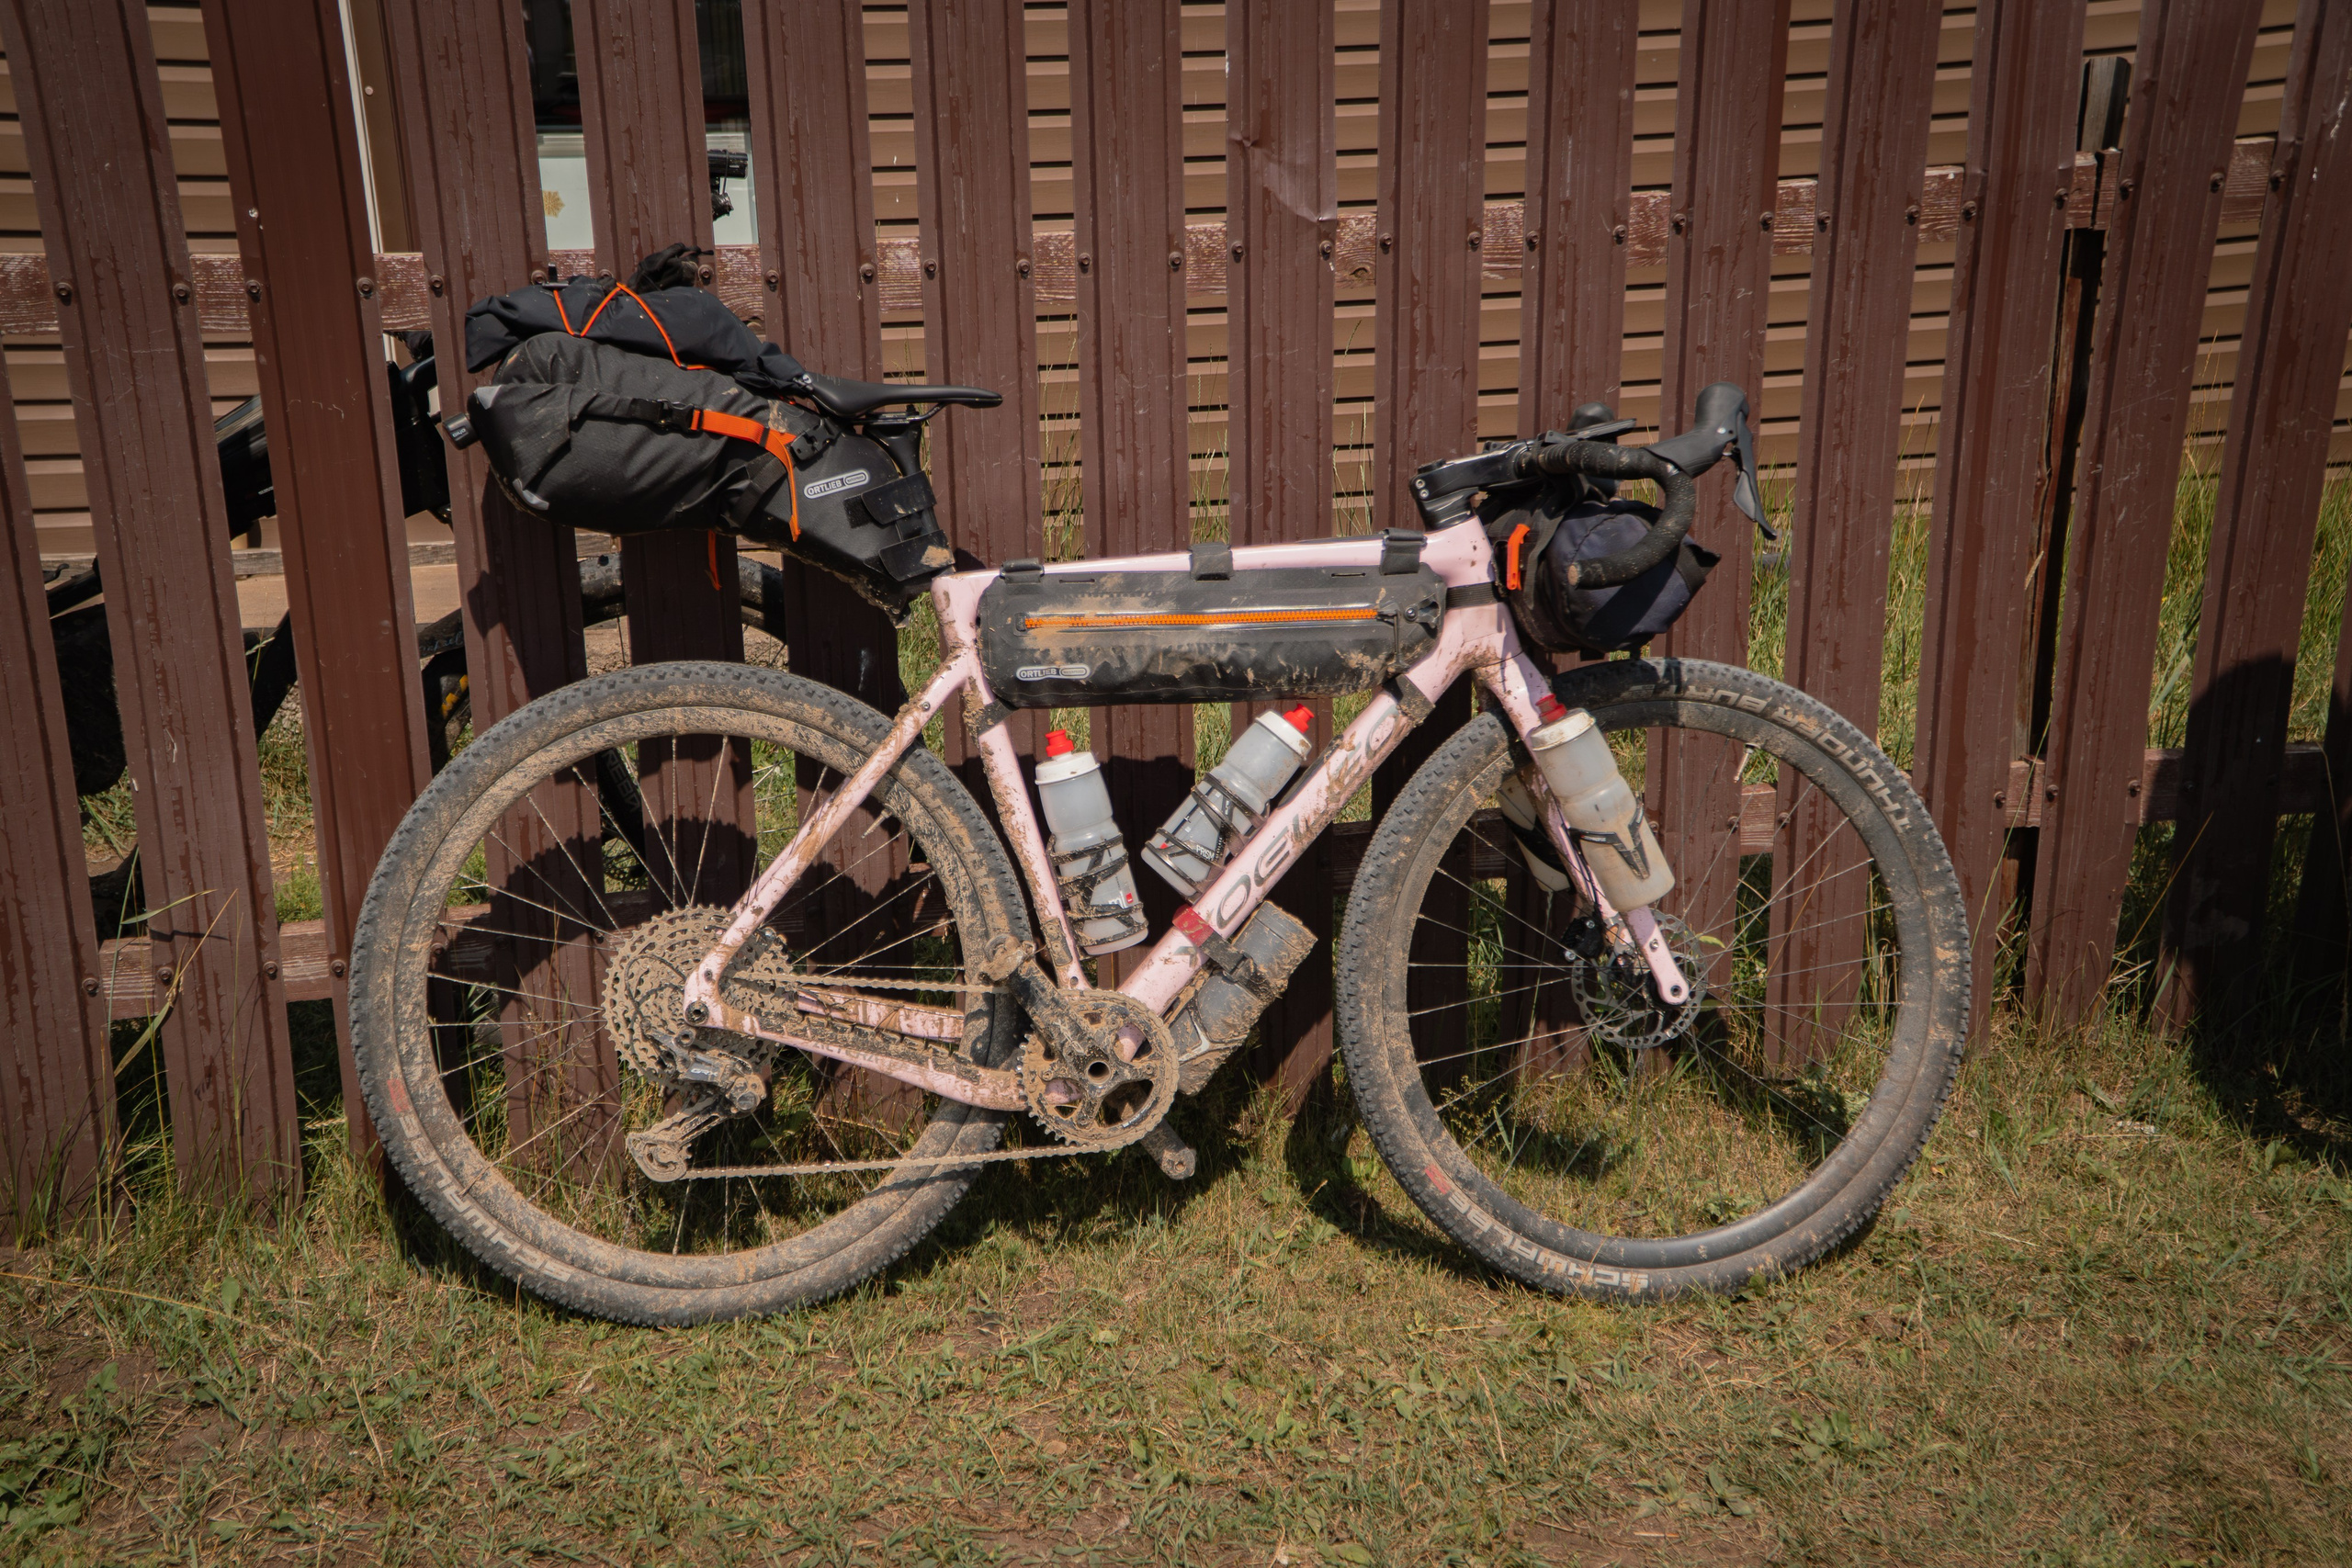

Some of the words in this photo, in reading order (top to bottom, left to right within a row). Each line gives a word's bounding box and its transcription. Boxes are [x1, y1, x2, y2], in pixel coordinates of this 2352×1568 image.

[808, 479, 842, 495] ORTLIEB
[1020, 668, 1057, 678] ORTLIEB
[1658, 683, 1773, 714] BURT
[1772, 705, 1909, 834] THUNDER
[1196, 844, 1216, 862] PRISM
[400, 1114, 573, 1282] SCHWALBE
[1449, 1193, 1649, 1291] SCHWALBE
